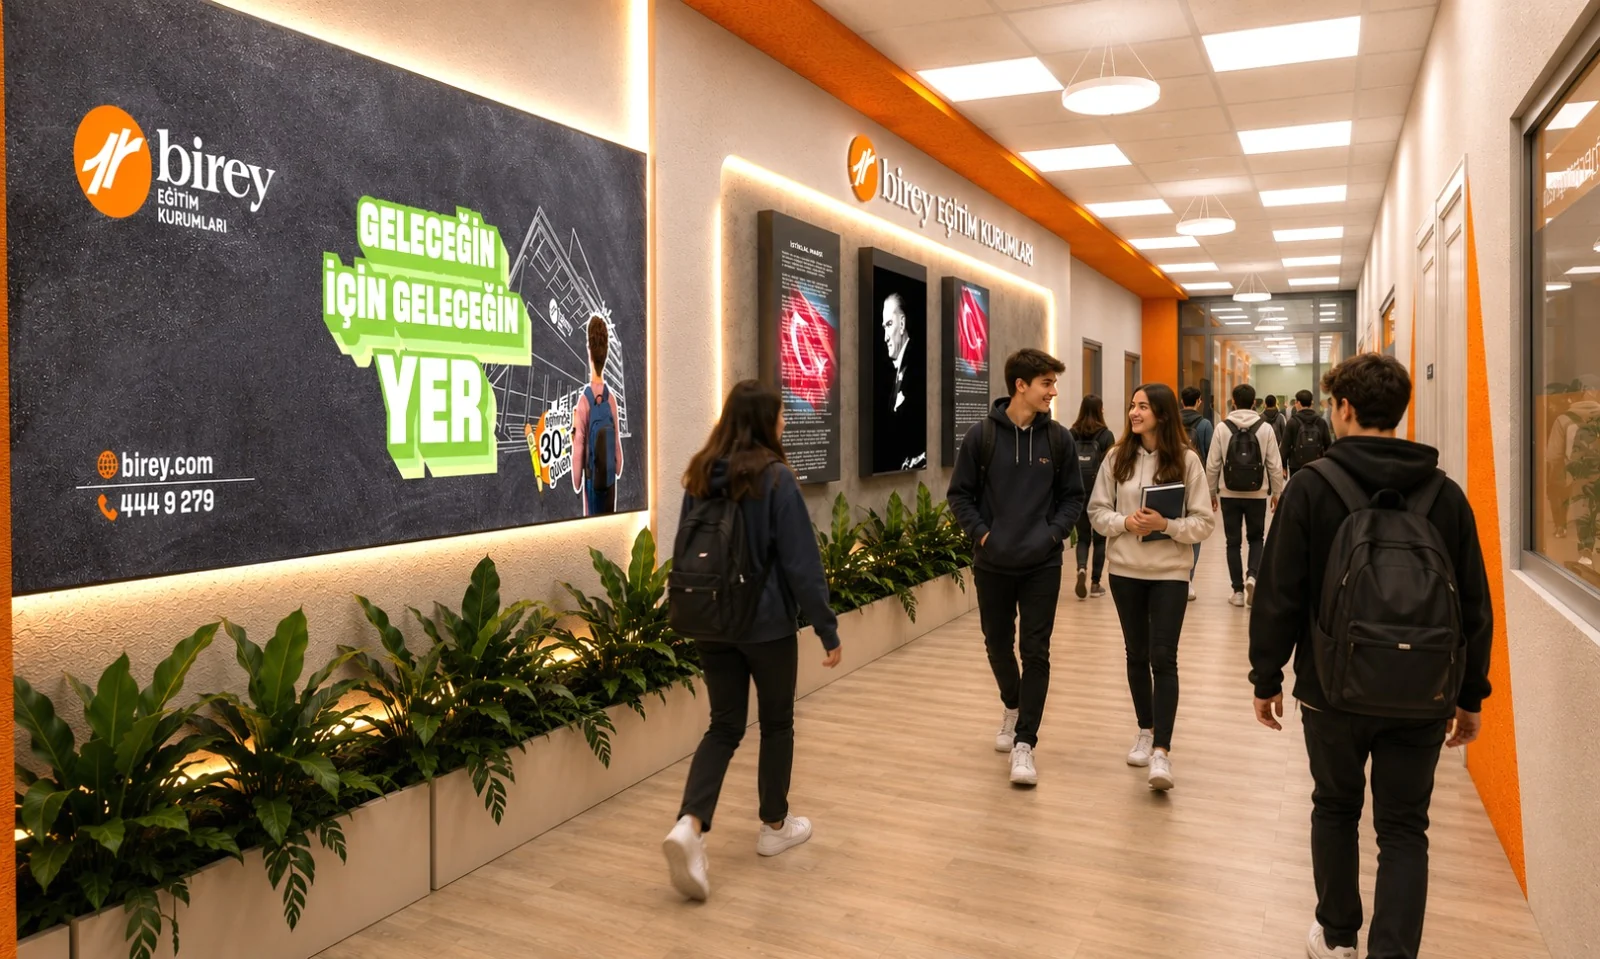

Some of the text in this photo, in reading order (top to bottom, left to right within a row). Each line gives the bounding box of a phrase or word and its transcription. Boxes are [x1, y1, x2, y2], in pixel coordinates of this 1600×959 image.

[156, 129, 276, 212] birey
[158, 187, 199, 211] EĞİTİM
[158, 208, 227, 233] KURUMLARI
[881, 158, 1034, 267] birey EĞİTİM KURUMLARI
[360, 201, 495, 268] GELECEĞİN
[326, 259, 519, 334] İÇİN GELECEĞİN
[376, 353, 483, 444] YER
[122, 451, 213, 481] birey.com
[541, 429, 562, 464] 30
[120, 489, 215, 518] 444 9 279
